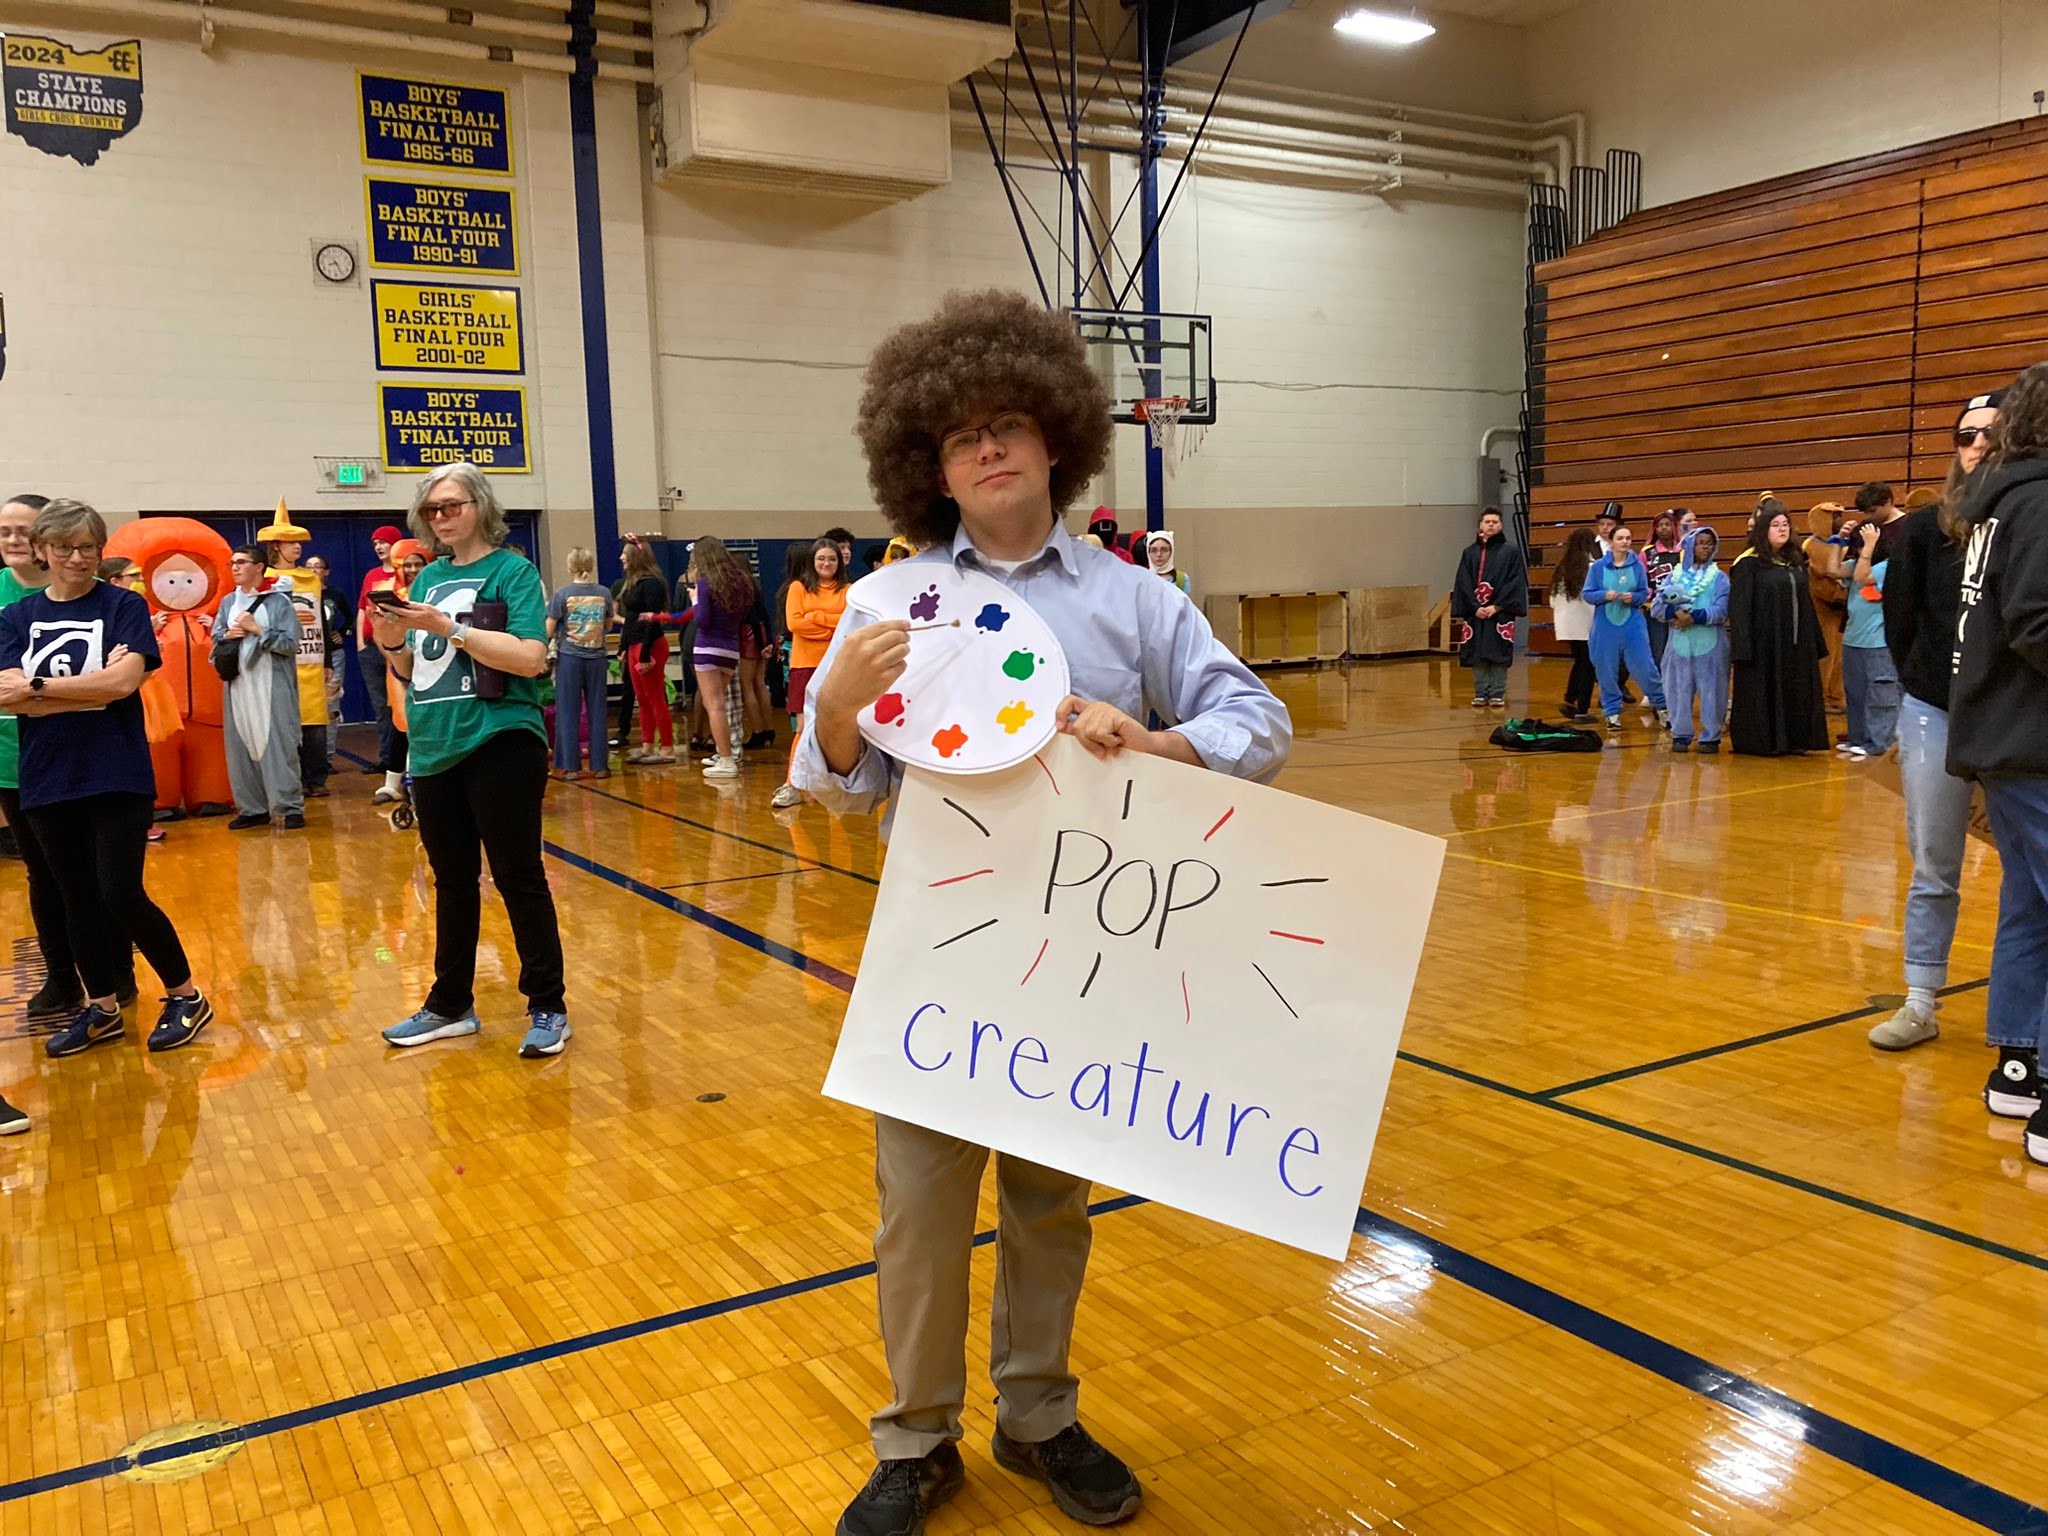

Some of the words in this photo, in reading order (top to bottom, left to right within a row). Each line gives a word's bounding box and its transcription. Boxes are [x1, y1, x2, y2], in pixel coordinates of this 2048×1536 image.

[7, 44, 66, 65] 2024
[38, 72, 103, 95] STATE
[15, 88, 127, 116] CHAMPIONS
[407, 84, 461, 106] BOYS'
[19, 109, 46, 122] GIRLS
[49, 112, 76, 125] CROSS
[79, 115, 120, 129] COUNTRY
[369, 99, 500, 130] BASKETBALL
[378, 119, 440, 142] FINAL
[444, 126, 494, 148] FOUR
[403, 142, 474, 164] 1965-66
[415, 187, 468, 208] BOYS'
[377, 203, 506, 230] BASKETBALL
[386, 224, 447, 244] FINAL
[450, 228, 500, 248] FOUR
[413, 244, 478, 265] 1990-91
[418, 291, 475, 309] GIRLS'
[384, 308, 511, 329] BASKETBALL
[393, 328, 452, 345] FINAL
[457, 331, 505, 347] FOUR
[416, 347, 486, 365] 2001-02
[426, 391, 479, 409] BOYS'
[390, 410, 518, 428] BASKETBALL
[399, 428, 459, 445] FINAL
[462, 429, 511, 446] FOUR
[420, 447, 494, 463] 2005-06
[33, 629, 41, 639] 6
[49, 653, 72, 678] 6
[461, 675, 471, 692] 8
[1043, 828, 1221, 950] POP
